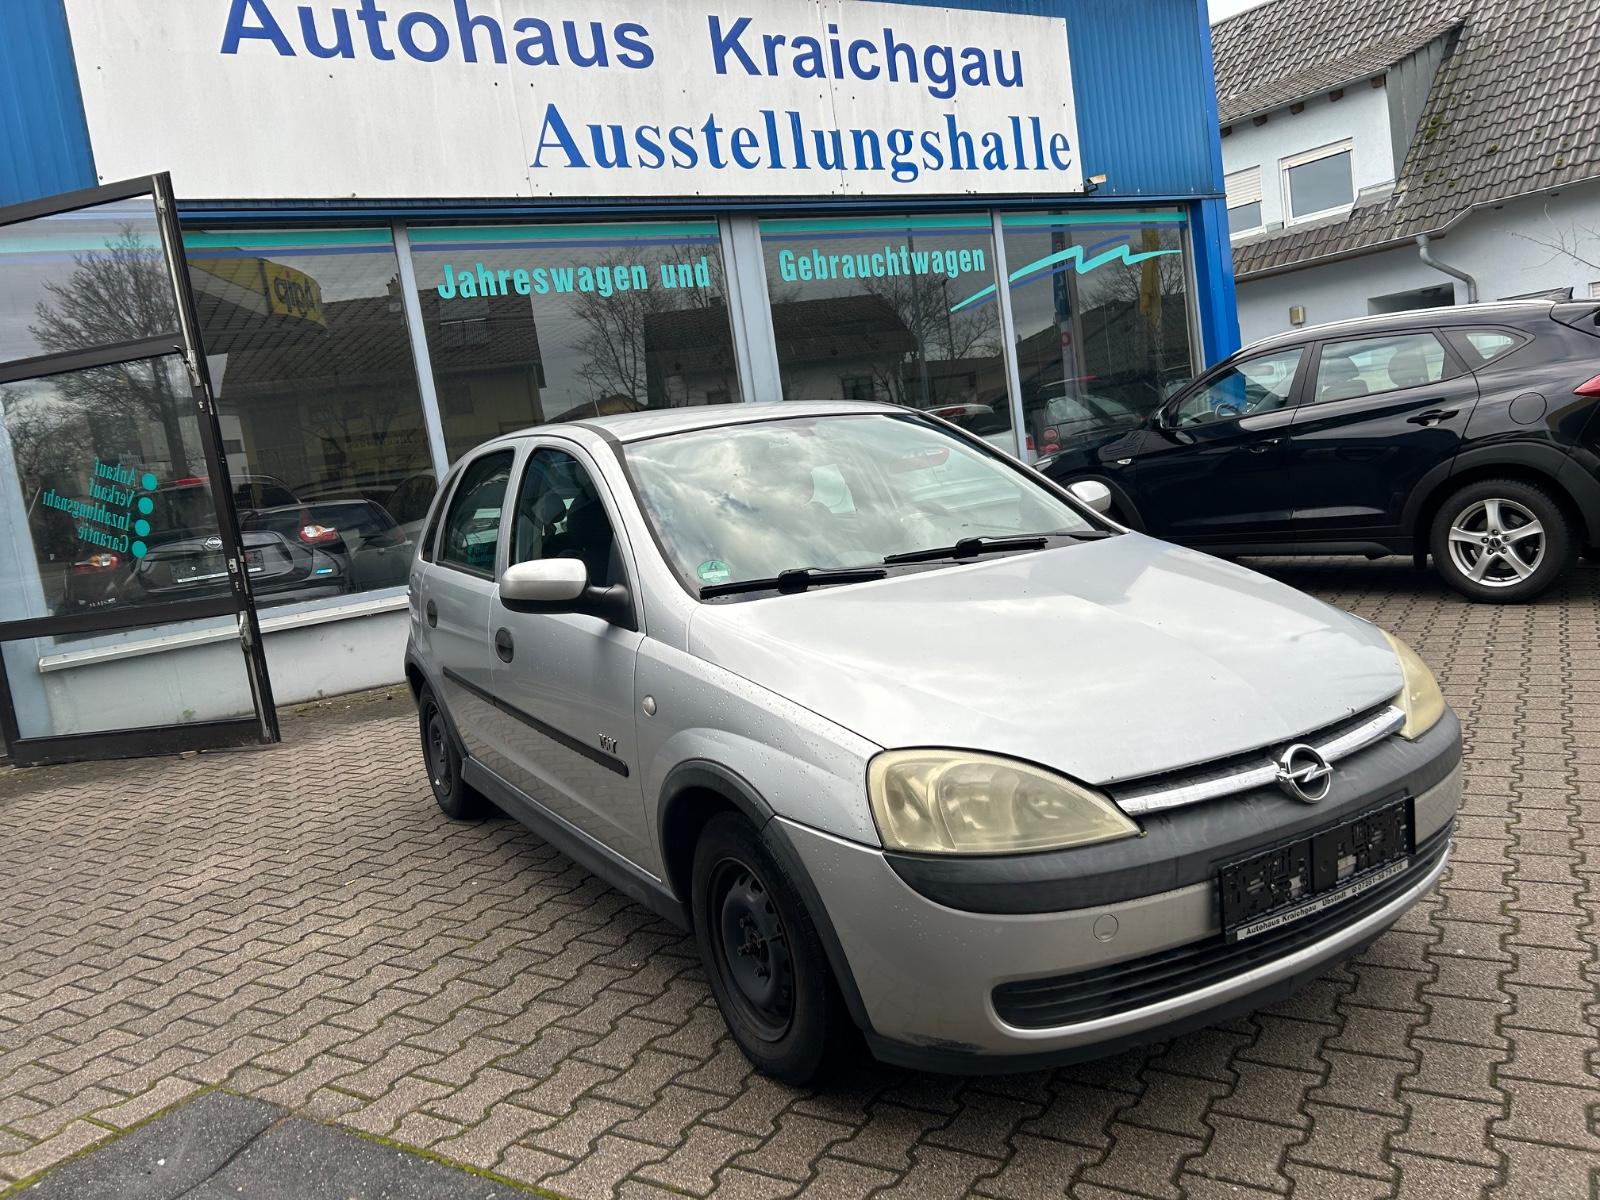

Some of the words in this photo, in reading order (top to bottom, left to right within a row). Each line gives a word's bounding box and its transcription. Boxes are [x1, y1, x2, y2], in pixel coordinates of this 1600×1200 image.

[220, 0, 655, 70] Autohaus
[707, 14, 1024, 100] Kraichgau
[529, 103, 1073, 184] Ausstellungshalle
[437, 263, 648, 301] Jahreswagen
[660, 255, 711, 290] und
[778, 244, 986, 283] Gebrauchtwagen
[1246, 919, 1280, 936] Autohaus
[1282, 903, 1317, 923] Kraichgau
